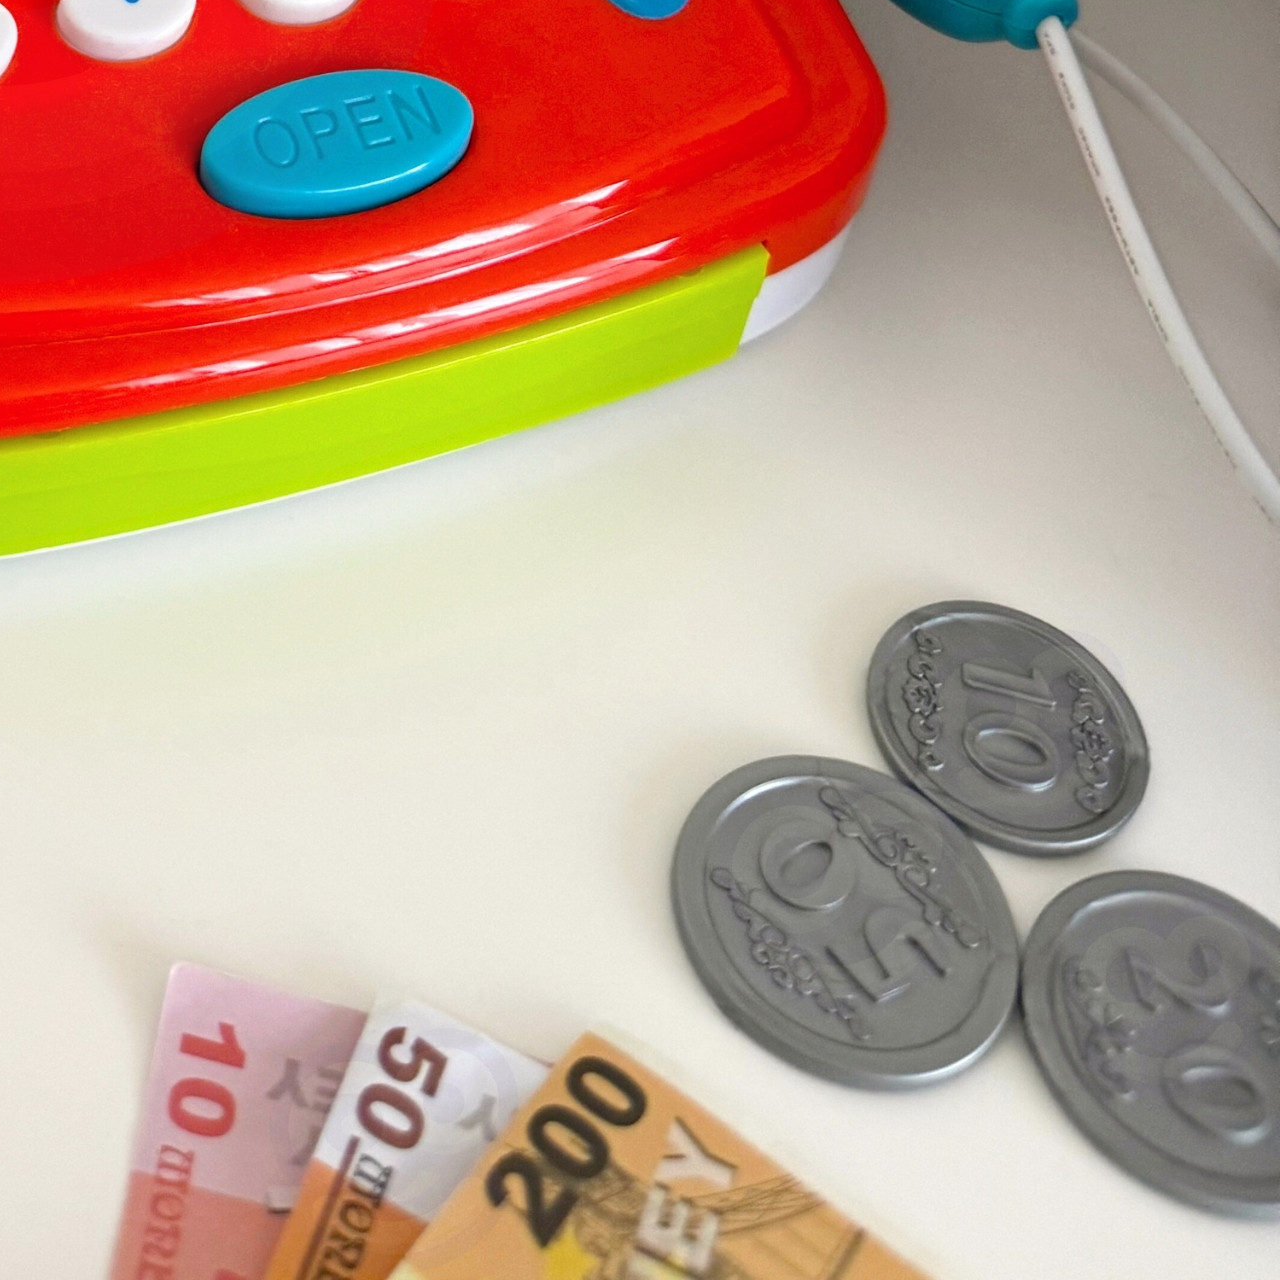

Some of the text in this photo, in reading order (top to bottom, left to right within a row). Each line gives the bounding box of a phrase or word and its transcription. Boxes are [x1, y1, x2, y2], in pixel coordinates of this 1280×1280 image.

[251, 84, 443, 169] OPEN
[166, 1021, 246, 1138] 10
[356, 1026, 448, 1149] 50
[484, 1055, 647, 1249] 200
